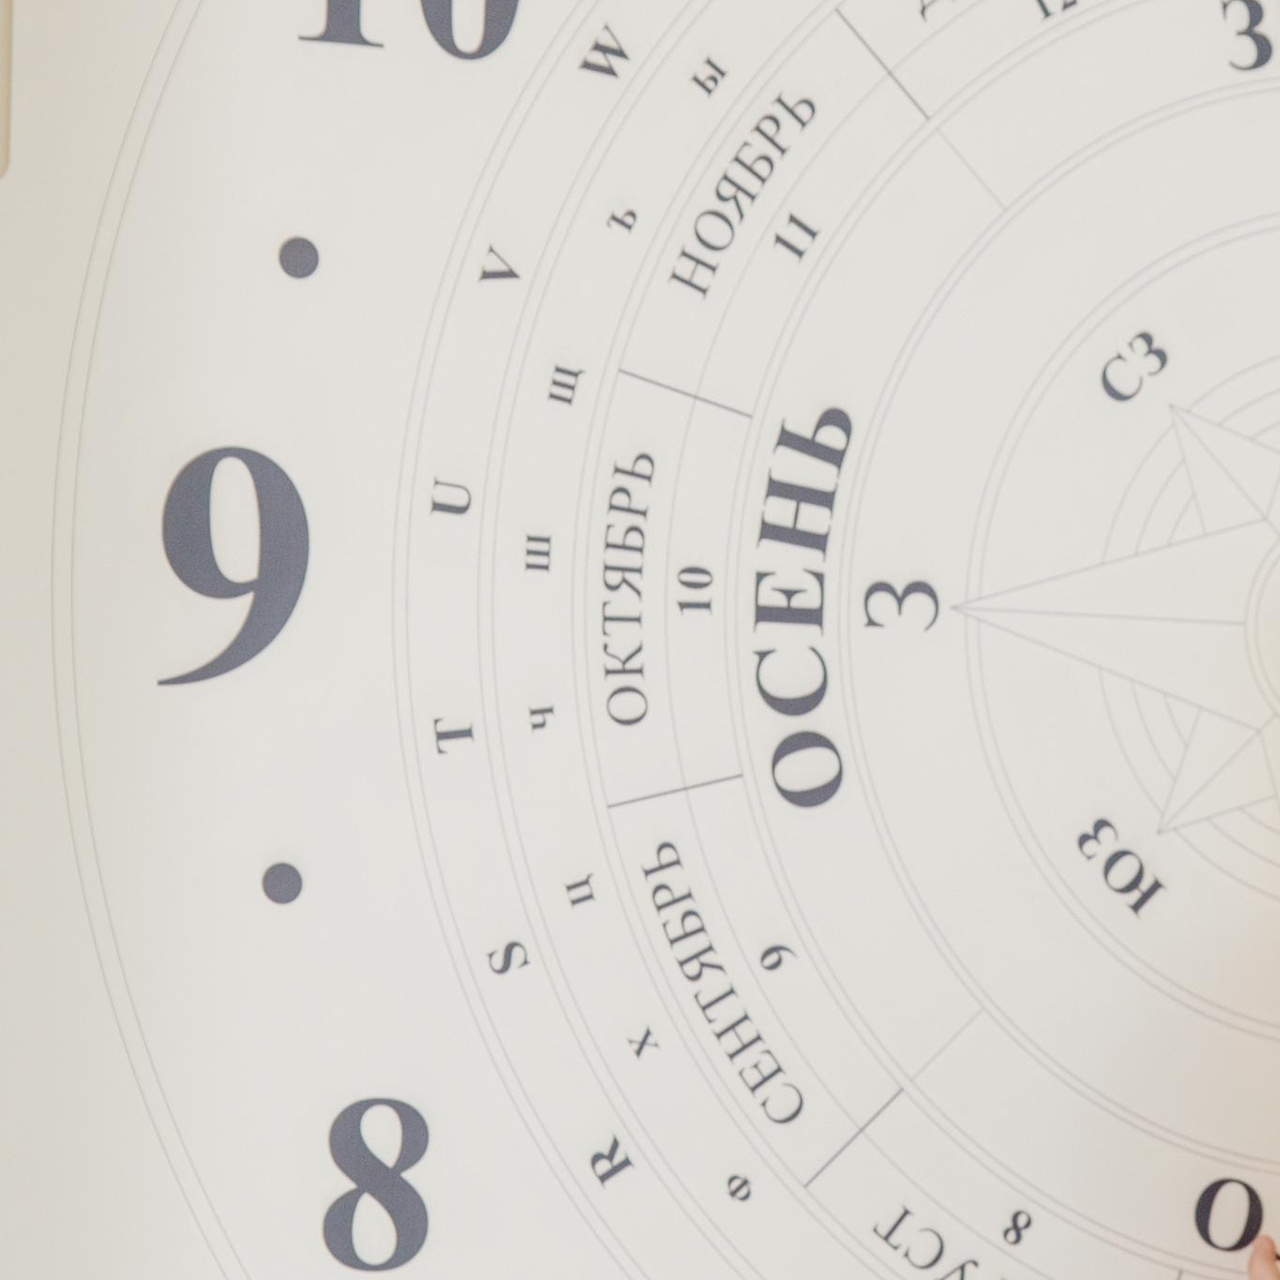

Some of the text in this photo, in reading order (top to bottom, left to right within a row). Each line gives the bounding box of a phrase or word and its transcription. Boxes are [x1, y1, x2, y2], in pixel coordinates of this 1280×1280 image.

[579, 24, 630, 78] W
[670, 91, 816, 298] НОЯБРЬ
[479, 245, 520, 281] V
[774, 213, 819, 260] 11
[1101, 331, 1168, 402] СЗ
[430, 478, 472, 515] U
[157, 446, 310, 686] 9
[602, 452, 655, 726] ОКТЯБРЬ
[677, 566, 713, 613] 10
[753, 407, 853, 809] ОСЕНЬ
[433, 718, 474, 754] T
[1077, 818, 1166, 917] ЮЗ
[487, 941, 530, 975] S
[642, 841, 804, 1125] СЕНТЯБРЬ
[322, 1097, 430, 1272] 8
[590, 1135, 634, 1187] R
[1003, 1210, 1033, 1246] 8
